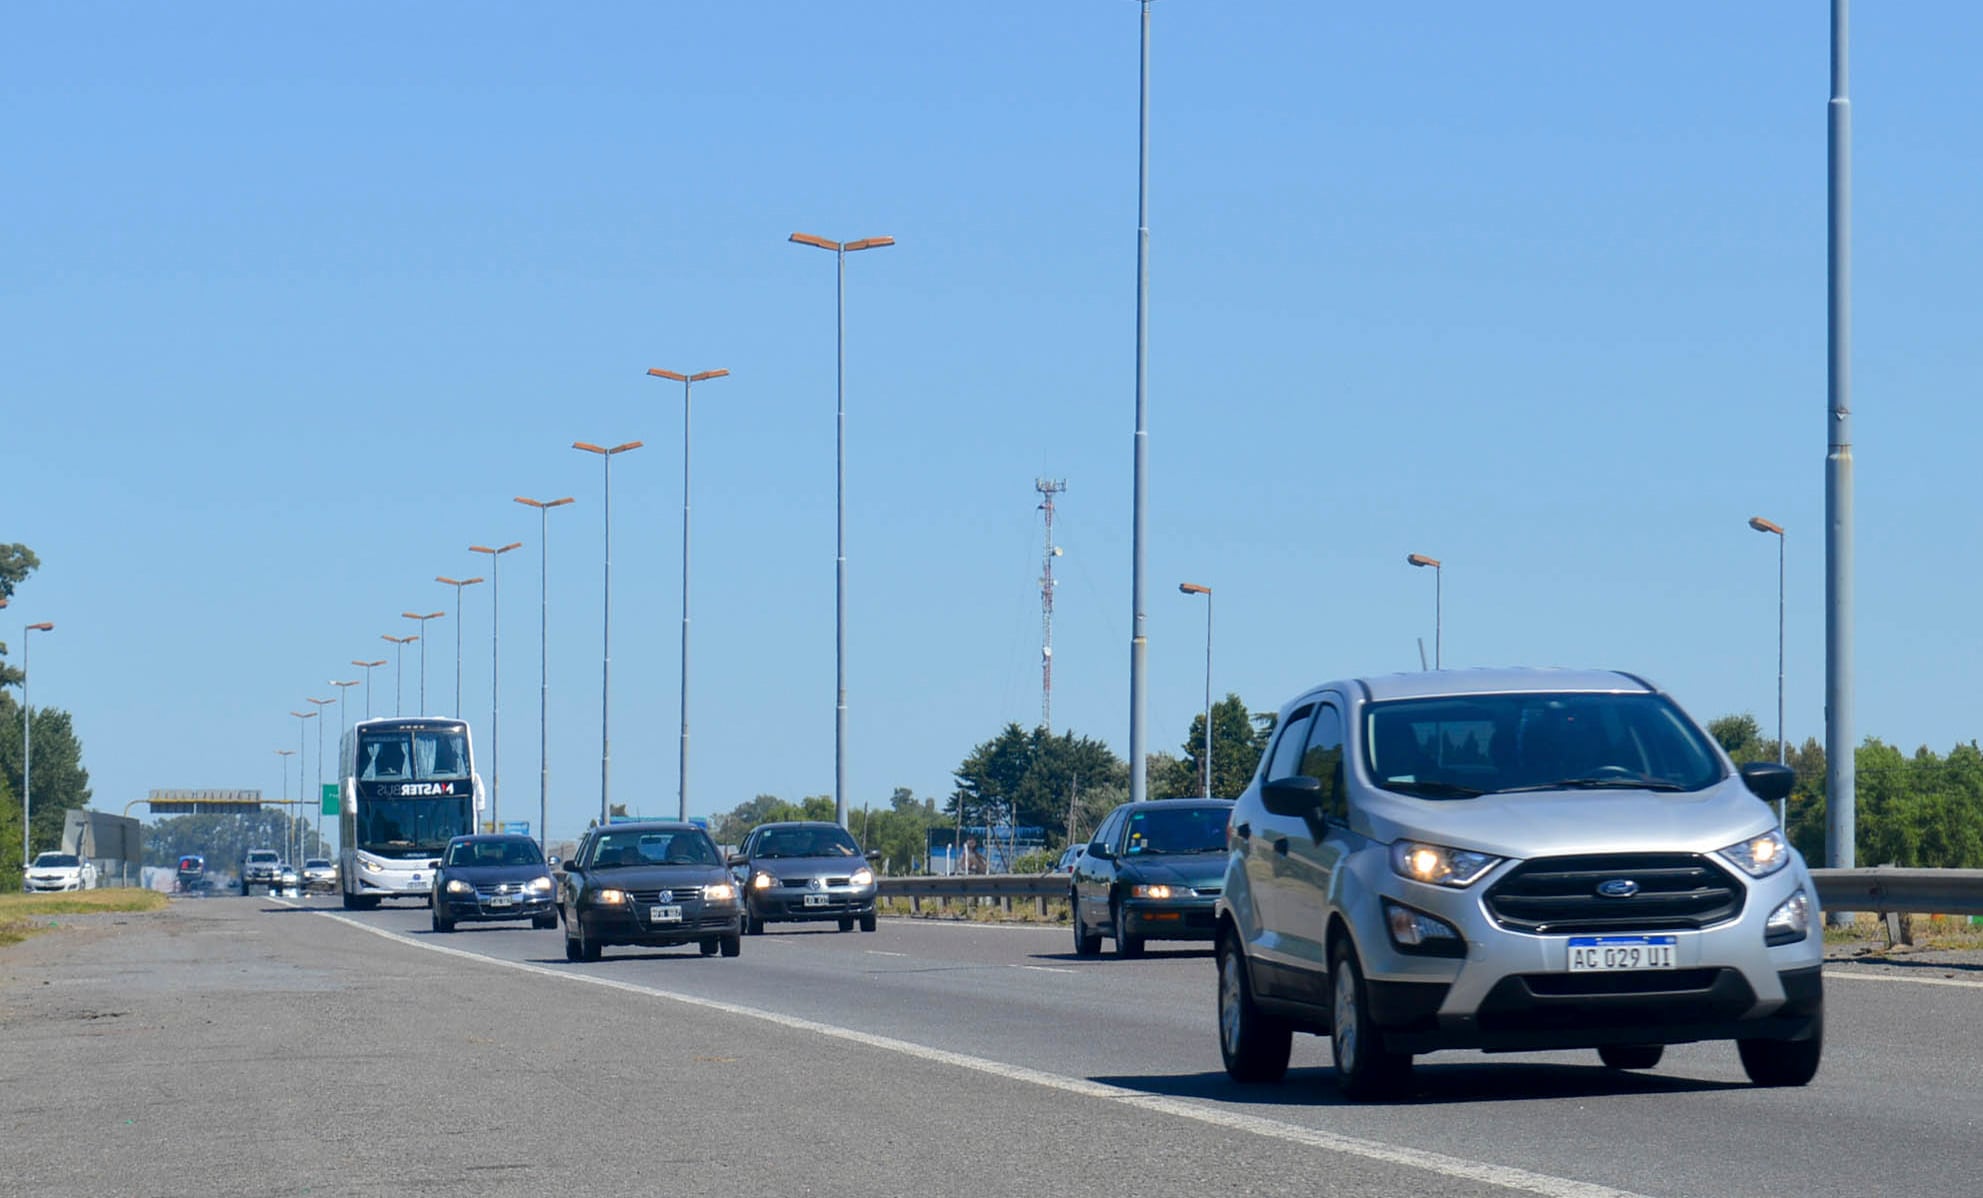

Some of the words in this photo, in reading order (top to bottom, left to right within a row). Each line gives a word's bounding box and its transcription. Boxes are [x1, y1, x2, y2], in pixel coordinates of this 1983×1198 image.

[1575, 948, 1598, 969] AC
[1604, 947, 1641, 968] 029
[1648, 946, 1671, 967] UI
